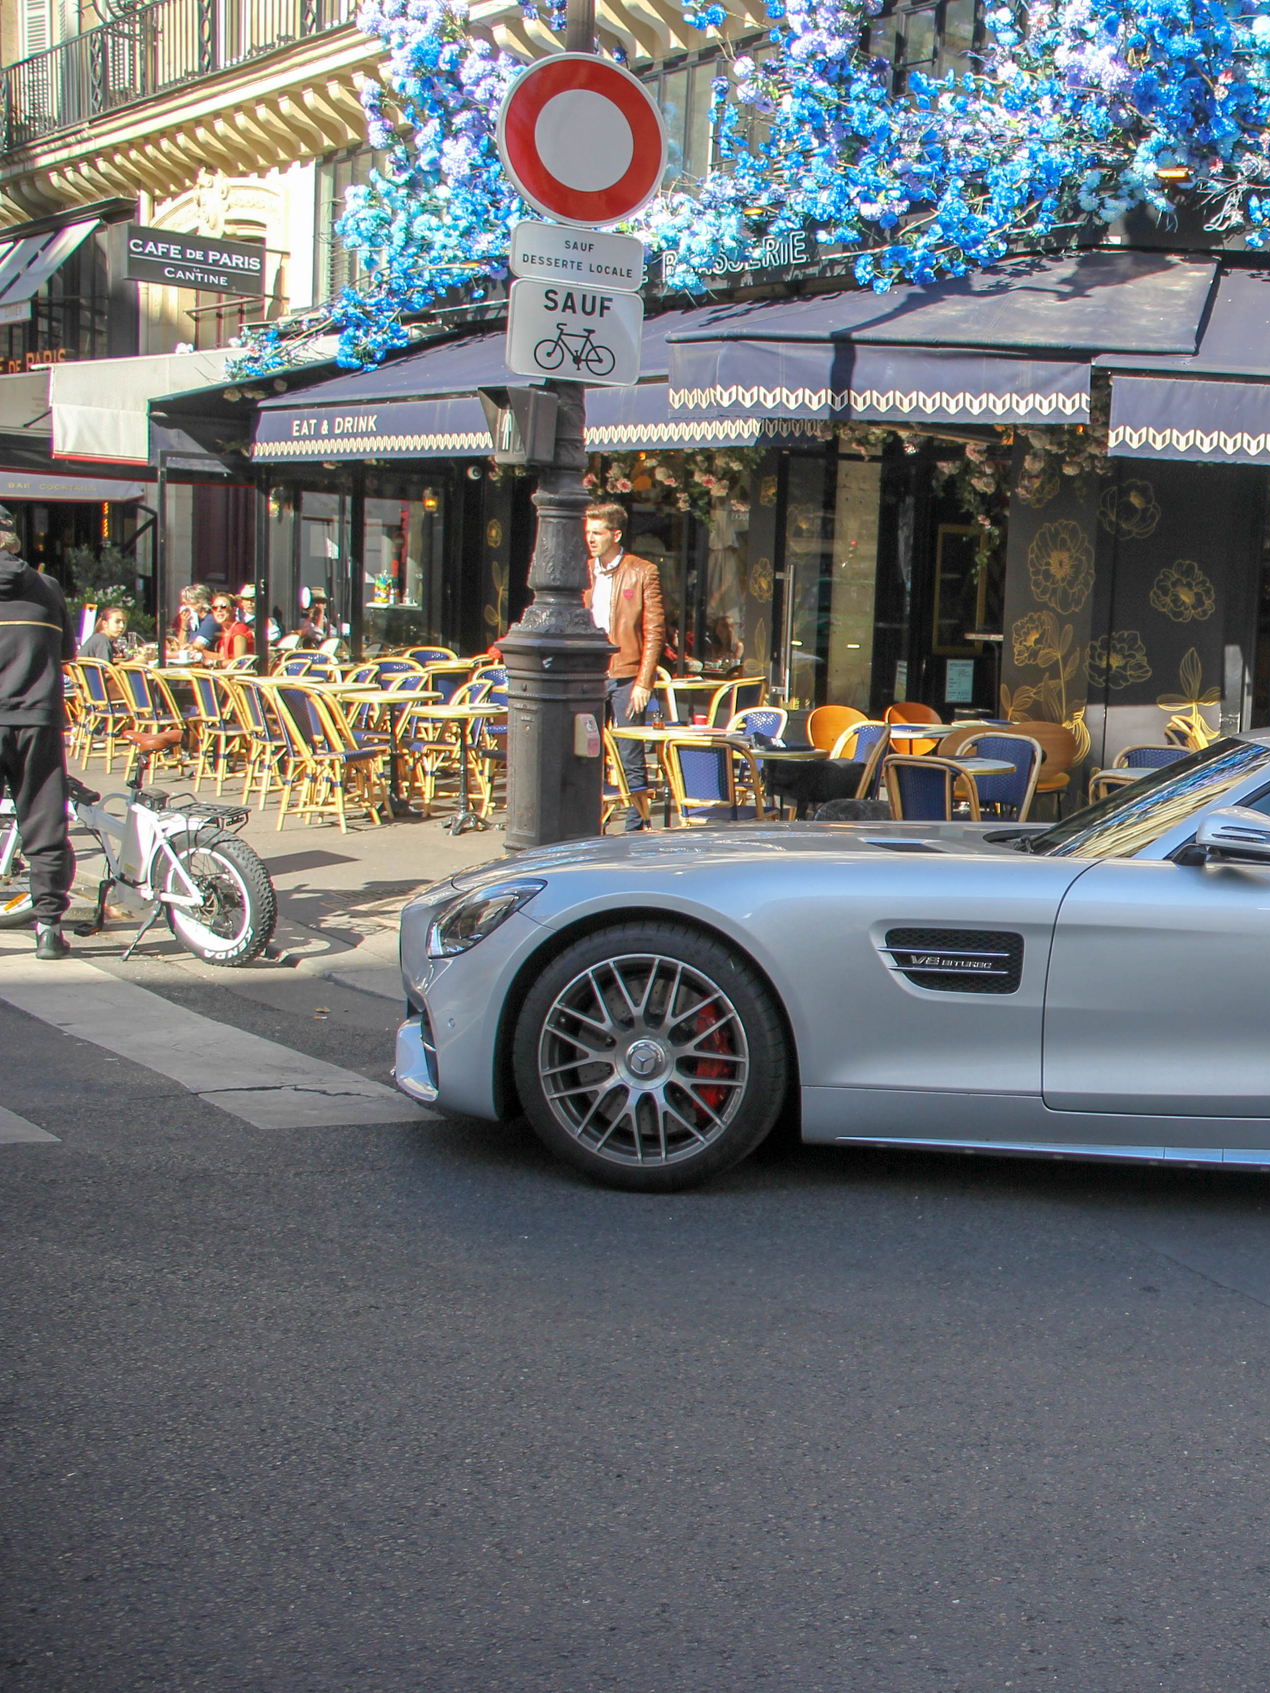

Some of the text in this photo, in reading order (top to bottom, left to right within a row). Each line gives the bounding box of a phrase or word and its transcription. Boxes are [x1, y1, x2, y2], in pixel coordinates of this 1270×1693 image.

[129, 239, 261, 270] CAFE DE PARIS
[564, 240, 595, 253] SAUF
[522, 253, 584, 272] DESSERTE
[589, 263, 634, 278] LOCALE
[164, 267, 228, 286] CANTINE
[543, 289, 614, 318] SAUF
[292, 414, 378, 437] EAT & DRINK
[39, 483, 97, 492] COCKTAILS
[911, 955, 992, 969] V8 BITURBO
